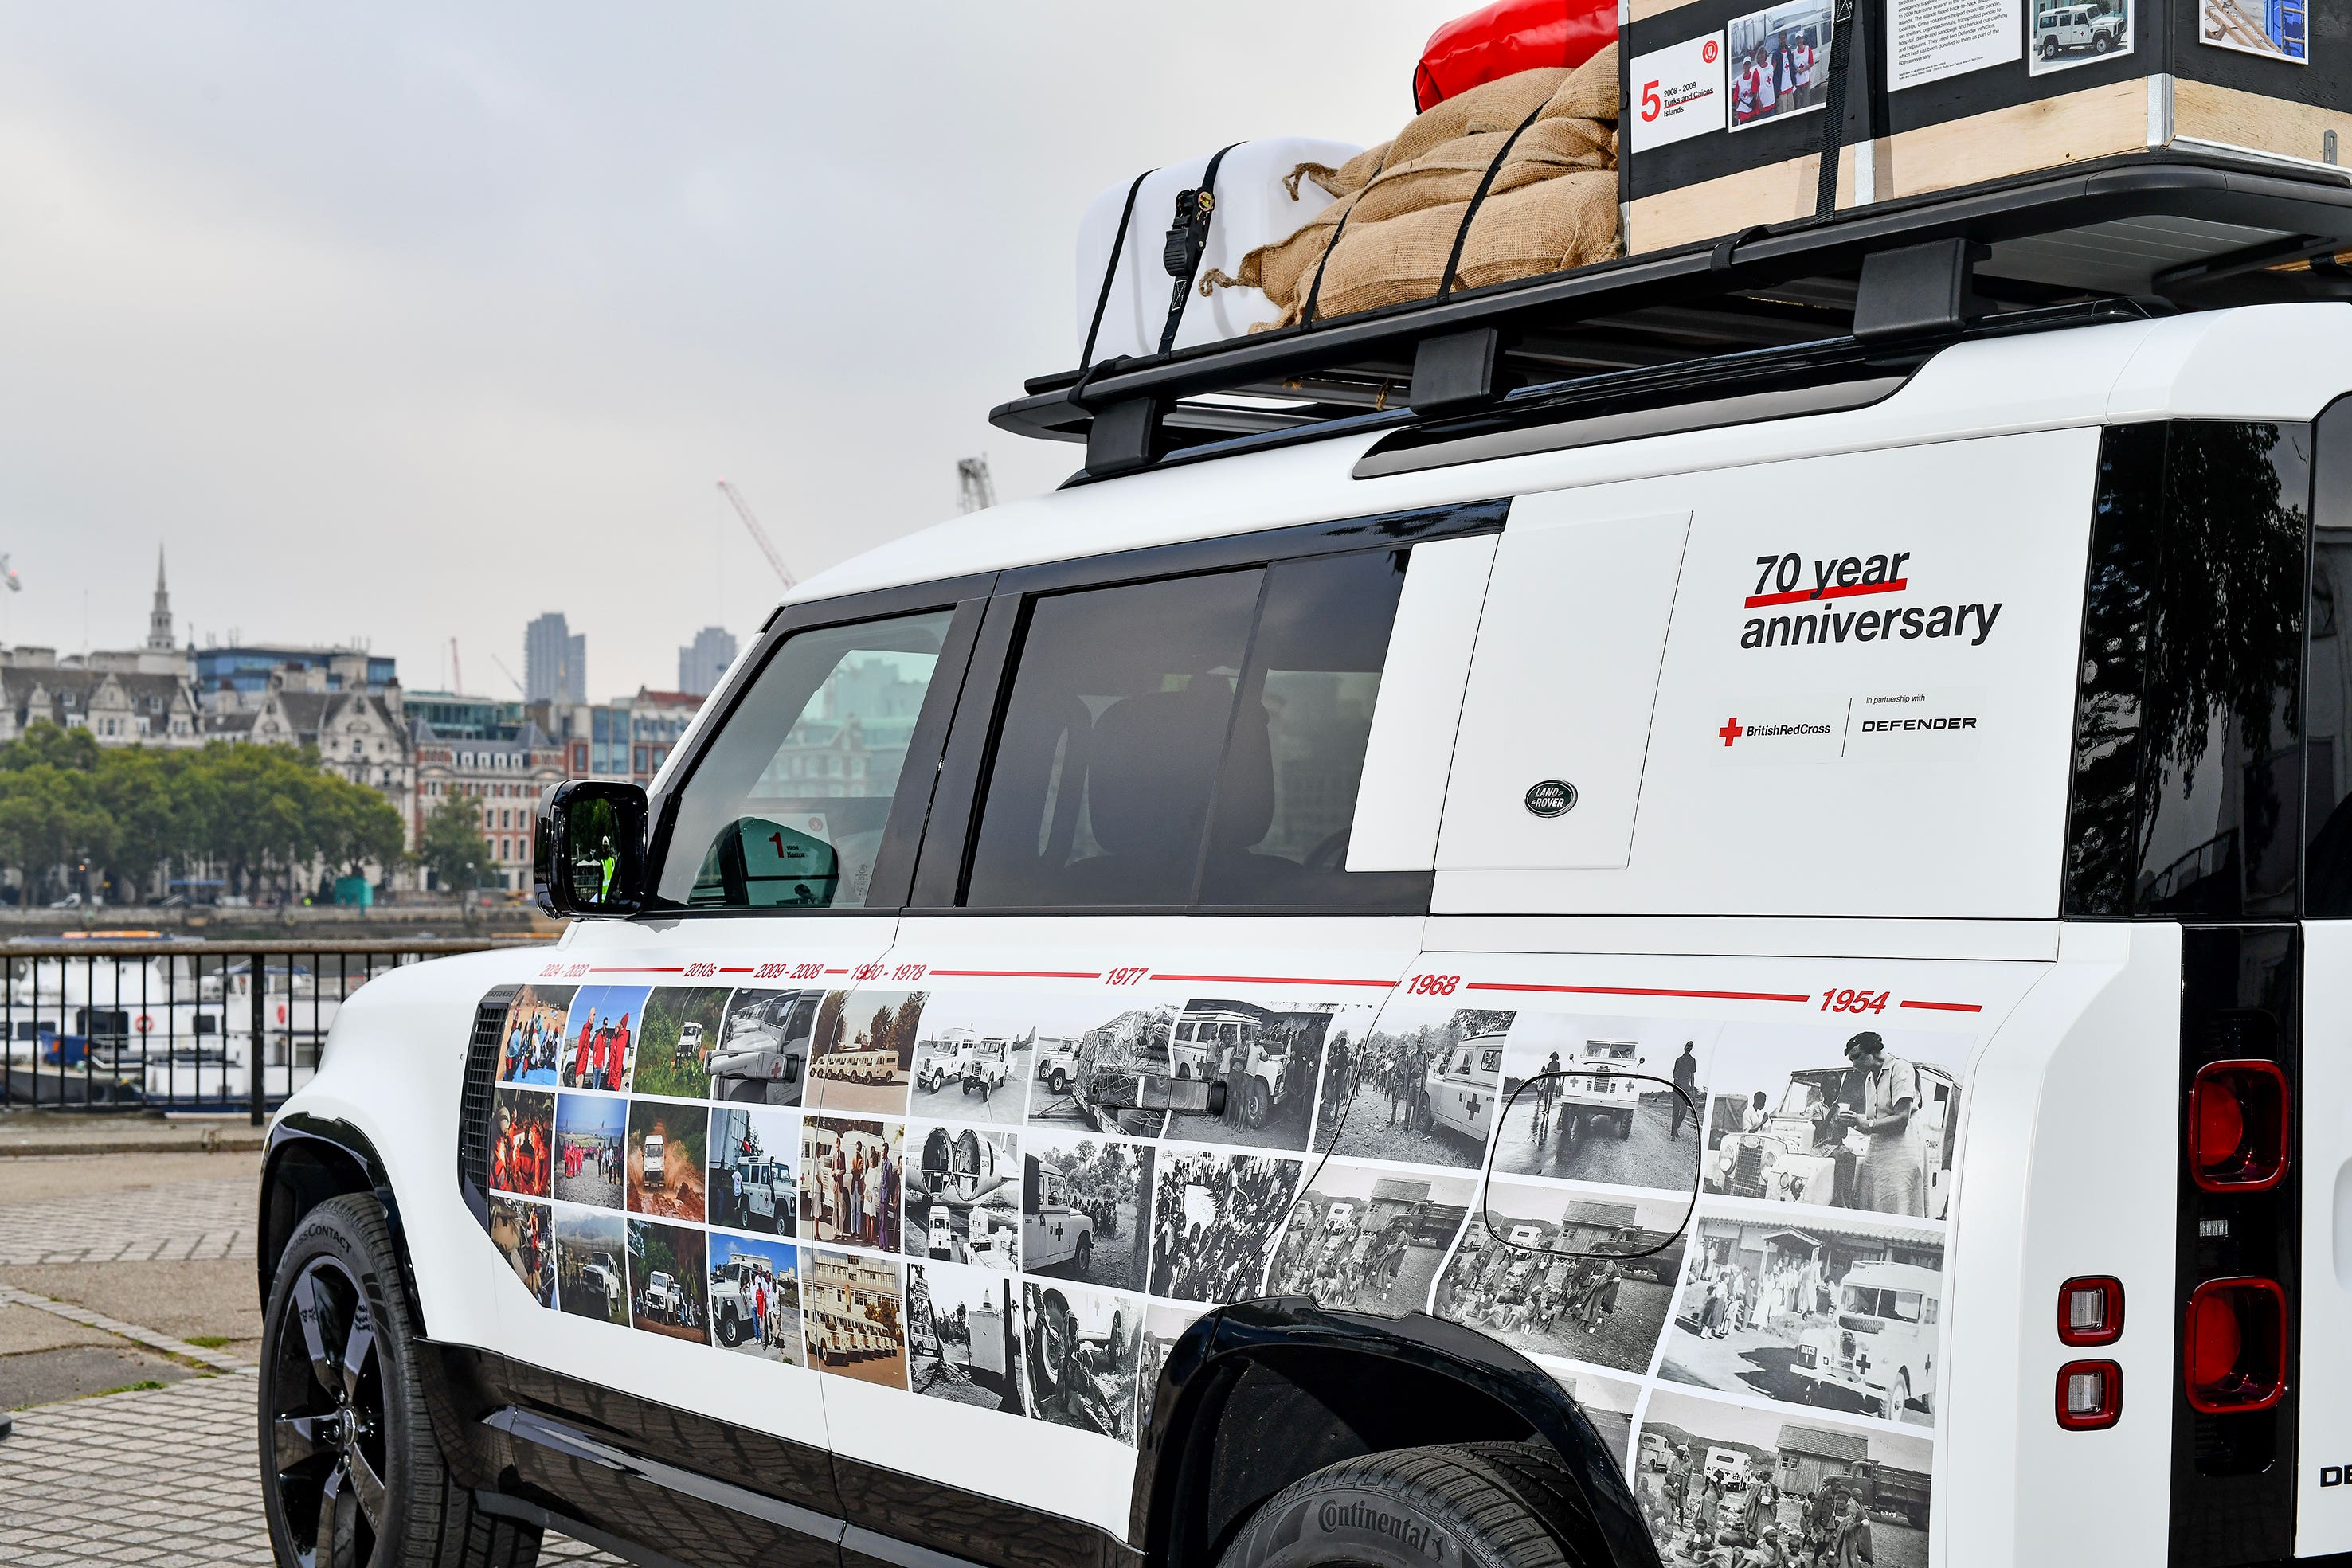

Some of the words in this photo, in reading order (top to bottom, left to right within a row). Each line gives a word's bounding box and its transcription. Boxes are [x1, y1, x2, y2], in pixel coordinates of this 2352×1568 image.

[1923, 23, 1943, 32] organised
[1958, 13, 1981, 23] transported
[1930, 15, 1950, 23] volunteers
[1916, 32, 1937, 41] distributed
[1958, 28, 1976, 36] Defender
[1938, 40, 1955, 48] donated
[1664, 87, 1677, 97] 2008
[1683, 82, 1696, 92] 2009
[1641, 80, 1660, 122] 5
[1664, 98, 1680, 108] Turks
[1681, 93, 1692, 102] and
[1693, 88, 1713, 98] Caicos
[1664, 106, 1684, 117] Islands
[1754, 552, 1801, 595] 70
[1809, 551, 1910, 600] year
[1740, 603, 2003, 649] anniversary
[1873, 695, 1910, 705] partnership
[1747, 724, 1831, 737] BritishRedCross
[1862, 717, 1977, 732] DEFENDER
[1535, 788, 1559, 797] LAND
[1535, 798, 1564, 807] ROVER
[769, 832, 784, 858] 1
[539, 964, 562, 977] 2024
[564, 964, 590, 977] 2023
[683, 963, 717, 977] 2010s
[754, 963, 787, 978] 2009
[790, 964, 824, 979] 2008
[851, 964, 885, 980] 1980
[891, 964, 927, 981] 1978
[1105, 967, 1149, 985] 1977
[1407, 974, 1460, 995] 1968
[1821, 988, 1890, 1014] 1954
[1318, 1499, 1430, 1554] Continental
